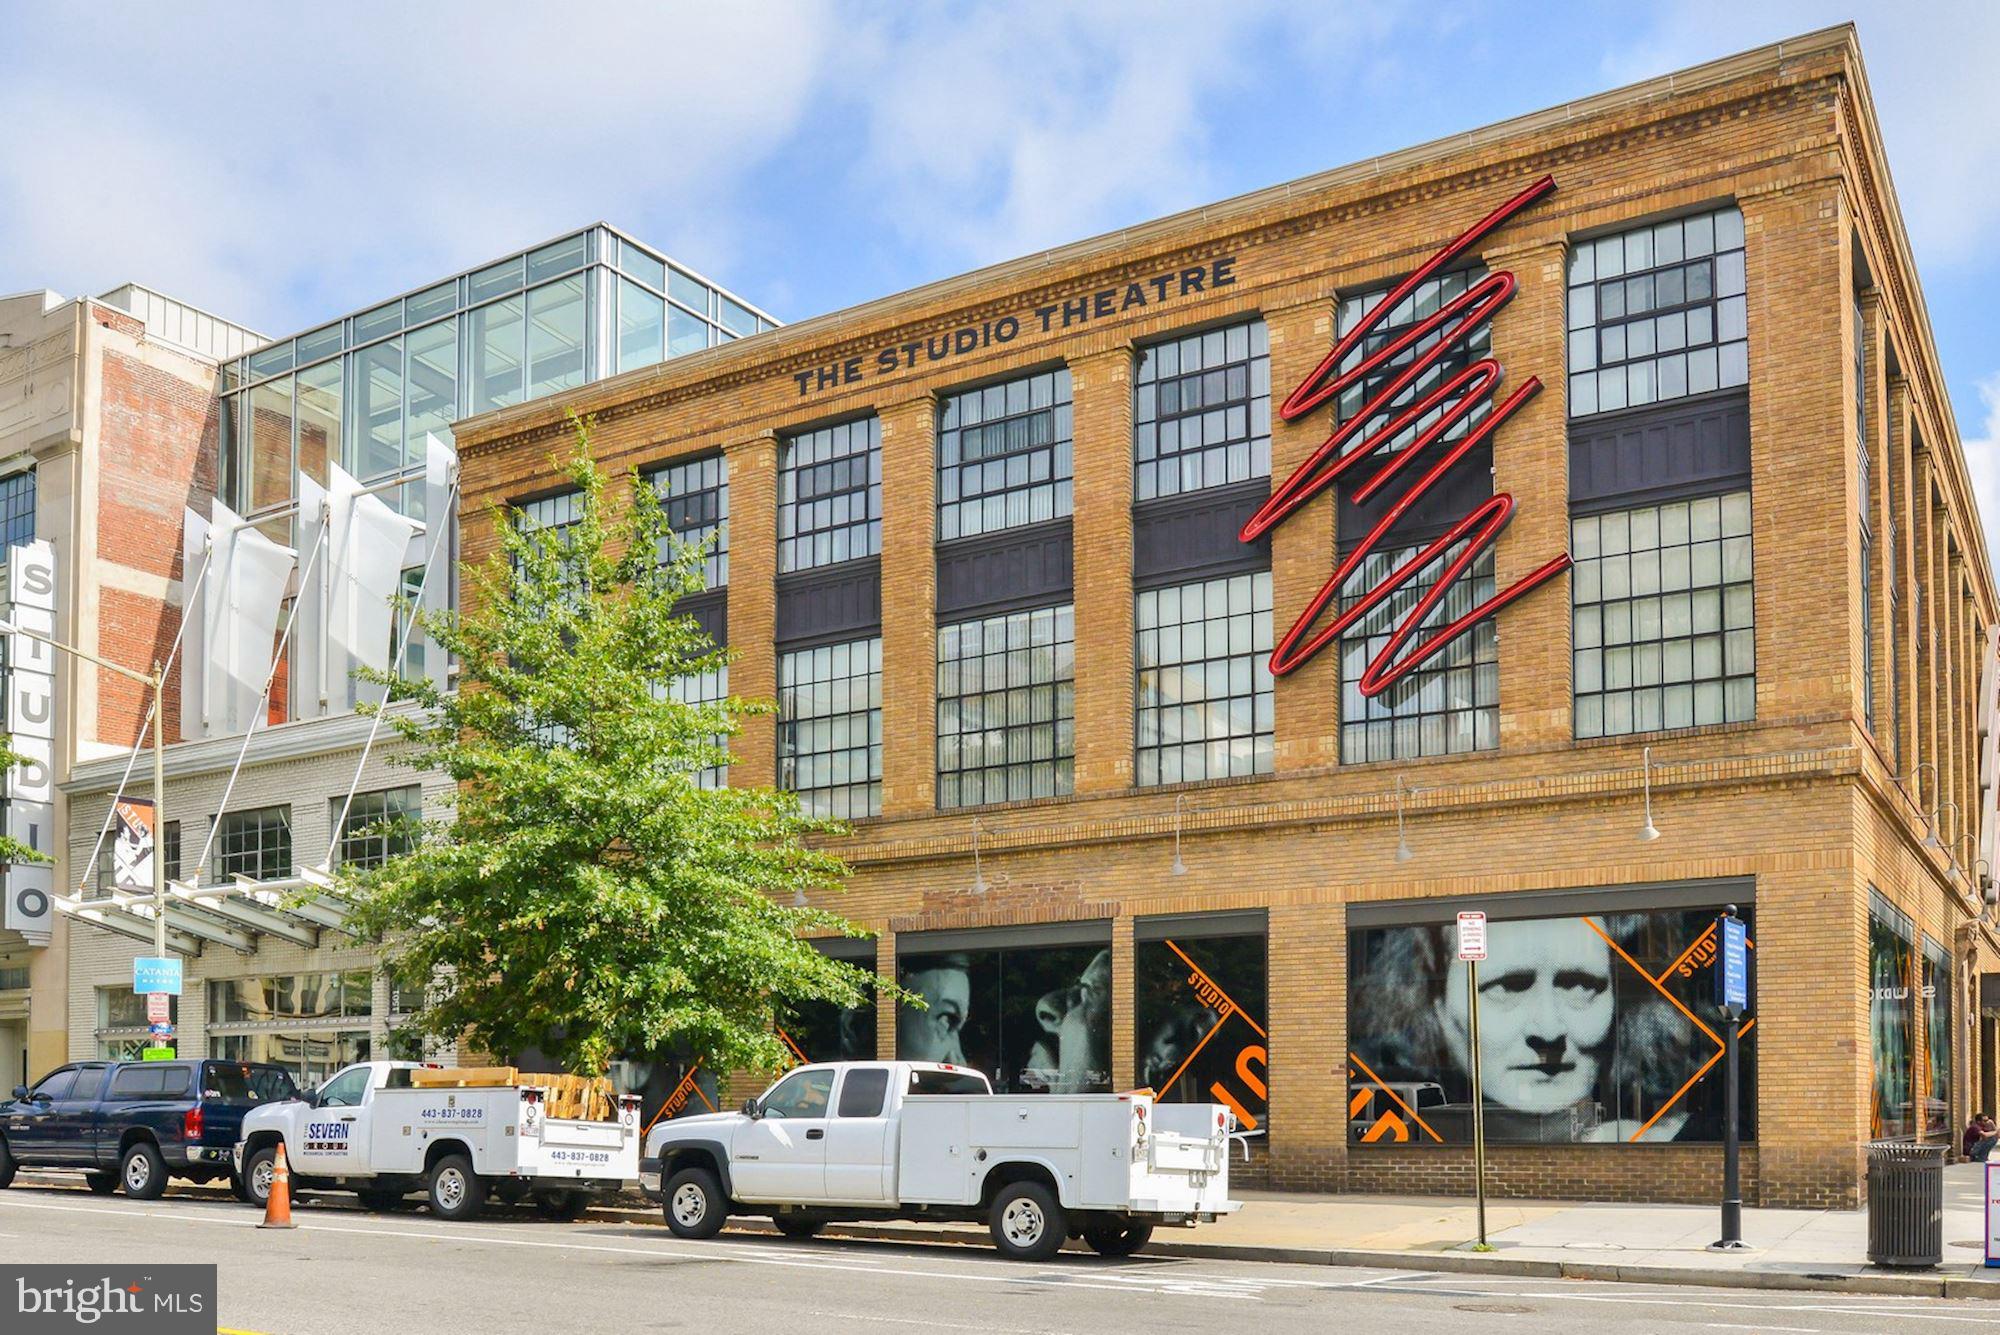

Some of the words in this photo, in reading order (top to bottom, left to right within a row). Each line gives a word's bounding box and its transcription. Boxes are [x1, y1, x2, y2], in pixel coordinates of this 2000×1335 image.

[794, 357, 863, 396] THE
[877, 316, 1019, 375] STUDIO
[1035, 257, 1237, 332] THEATRE
[17, 564, 53, 918] STUDIO
[1678, 932, 1718, 978] STUDI
[1187, 972, 1230, 1015] STUDIO
[421, 1108, 483, 1119] 443-837-0828
[665, 1082, 692, 1118] STUDIO
[303, 1142, 348, 1151] GROUP
[308, 1122, 349, 1139] SEVERN
[551, 1150, 610, 1163] 443-837-0828
